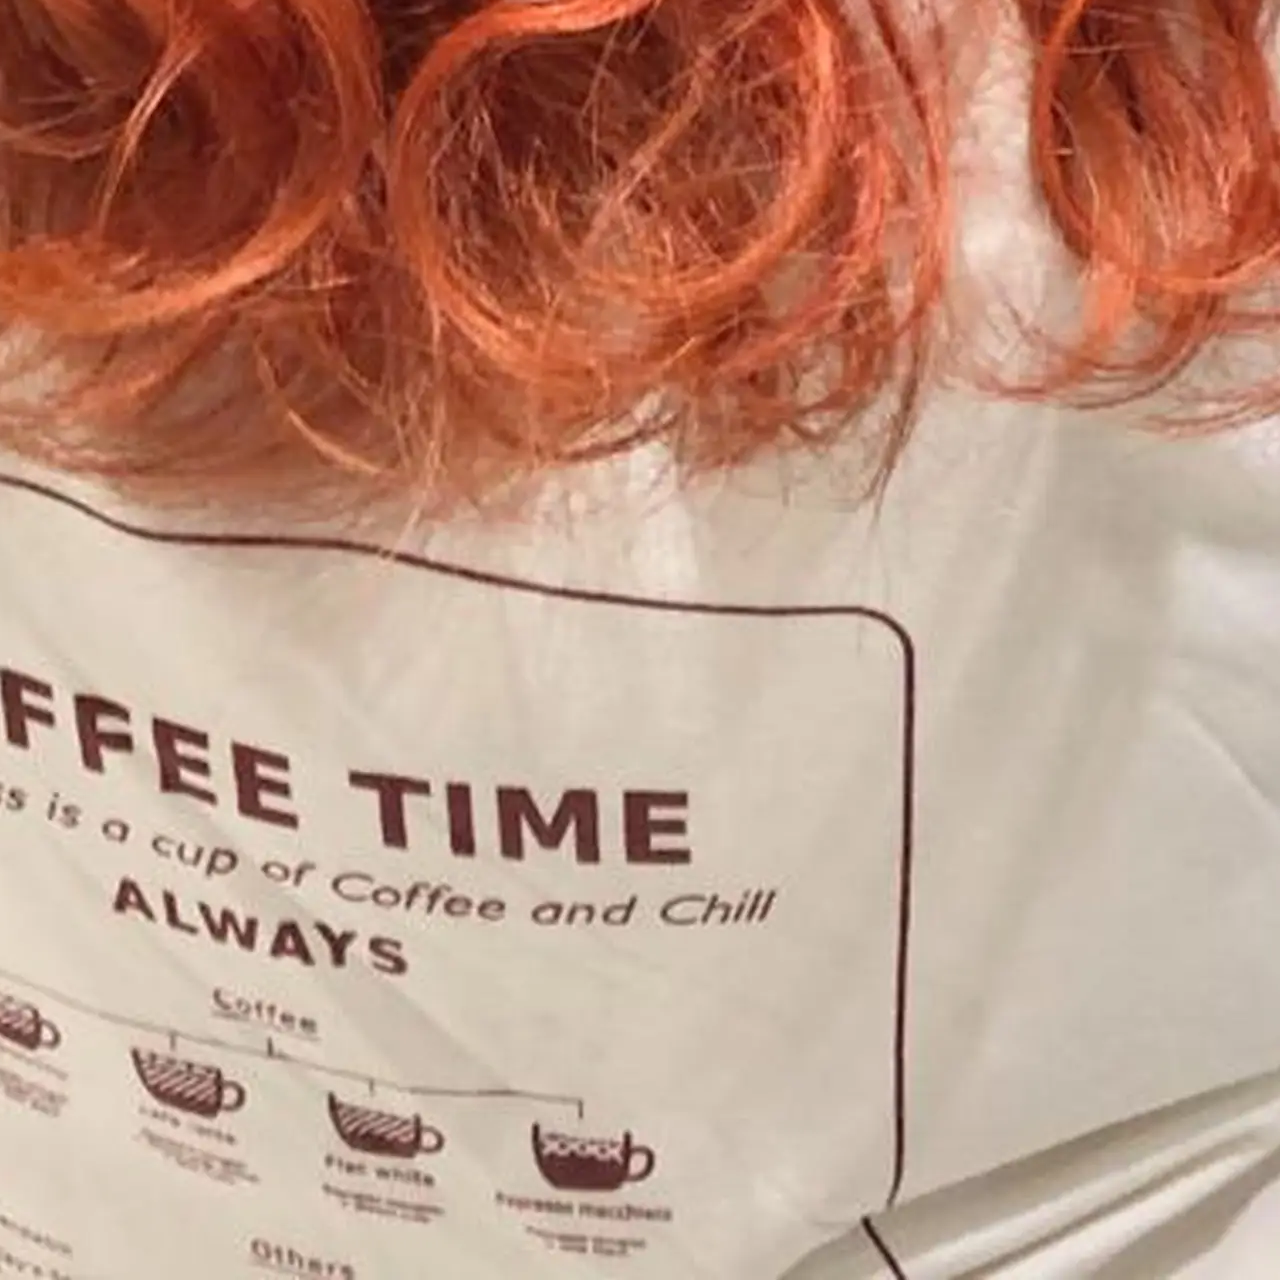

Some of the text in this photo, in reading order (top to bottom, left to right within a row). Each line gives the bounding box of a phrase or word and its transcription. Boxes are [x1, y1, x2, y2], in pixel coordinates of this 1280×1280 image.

[47, 792, 83, 829] is
[101, 817, 131, 844] a
[151, 834, 239, 878] cup
[261, 860, 316, 887] of
[331, 871, 506, 922] Coffee
[531, 896, 637, 927] and
[660, 888, 777, 927] Chill
[348, 769, 691, 865] TIME
[113, 877, 409, 976] ALWAYS
[212, 987, 319, 1034] Coffee
[250, 1238, 356, 1280] Others
